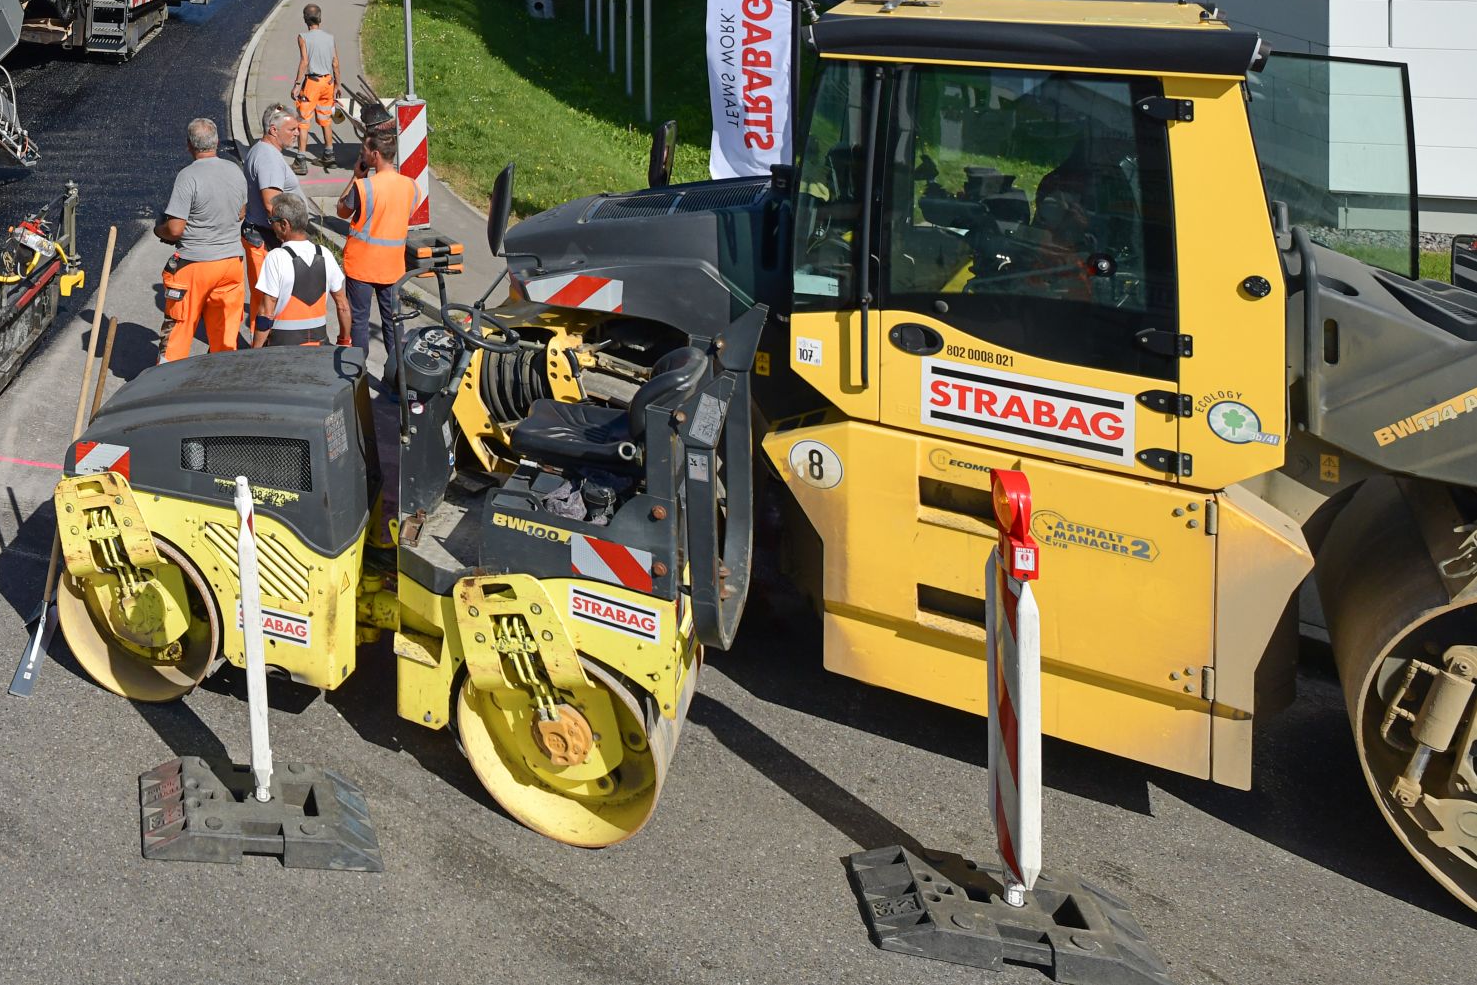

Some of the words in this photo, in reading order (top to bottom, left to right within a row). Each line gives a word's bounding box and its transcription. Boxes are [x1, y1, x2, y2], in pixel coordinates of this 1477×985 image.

[799, 348, 813, 362] 107
[947, 345, 966, 358] 802
[968, 348, 994, 364] 0008
[995, 353, 1014, 367] 021
[930, 380, 1124, 441] STRABAG
[1195, 390, 1242, 413] ECOLOGY
[808, 449, 823, 480] 8
[949, 459, 993, 473] ECOMO
[1055, 521, 1124, 543] ASPHALT
[1053, 531, 1129, 555] MANAGER
[1131, 540, 1151, 559] 2
[572, 597, 656, 632] STRABAG
